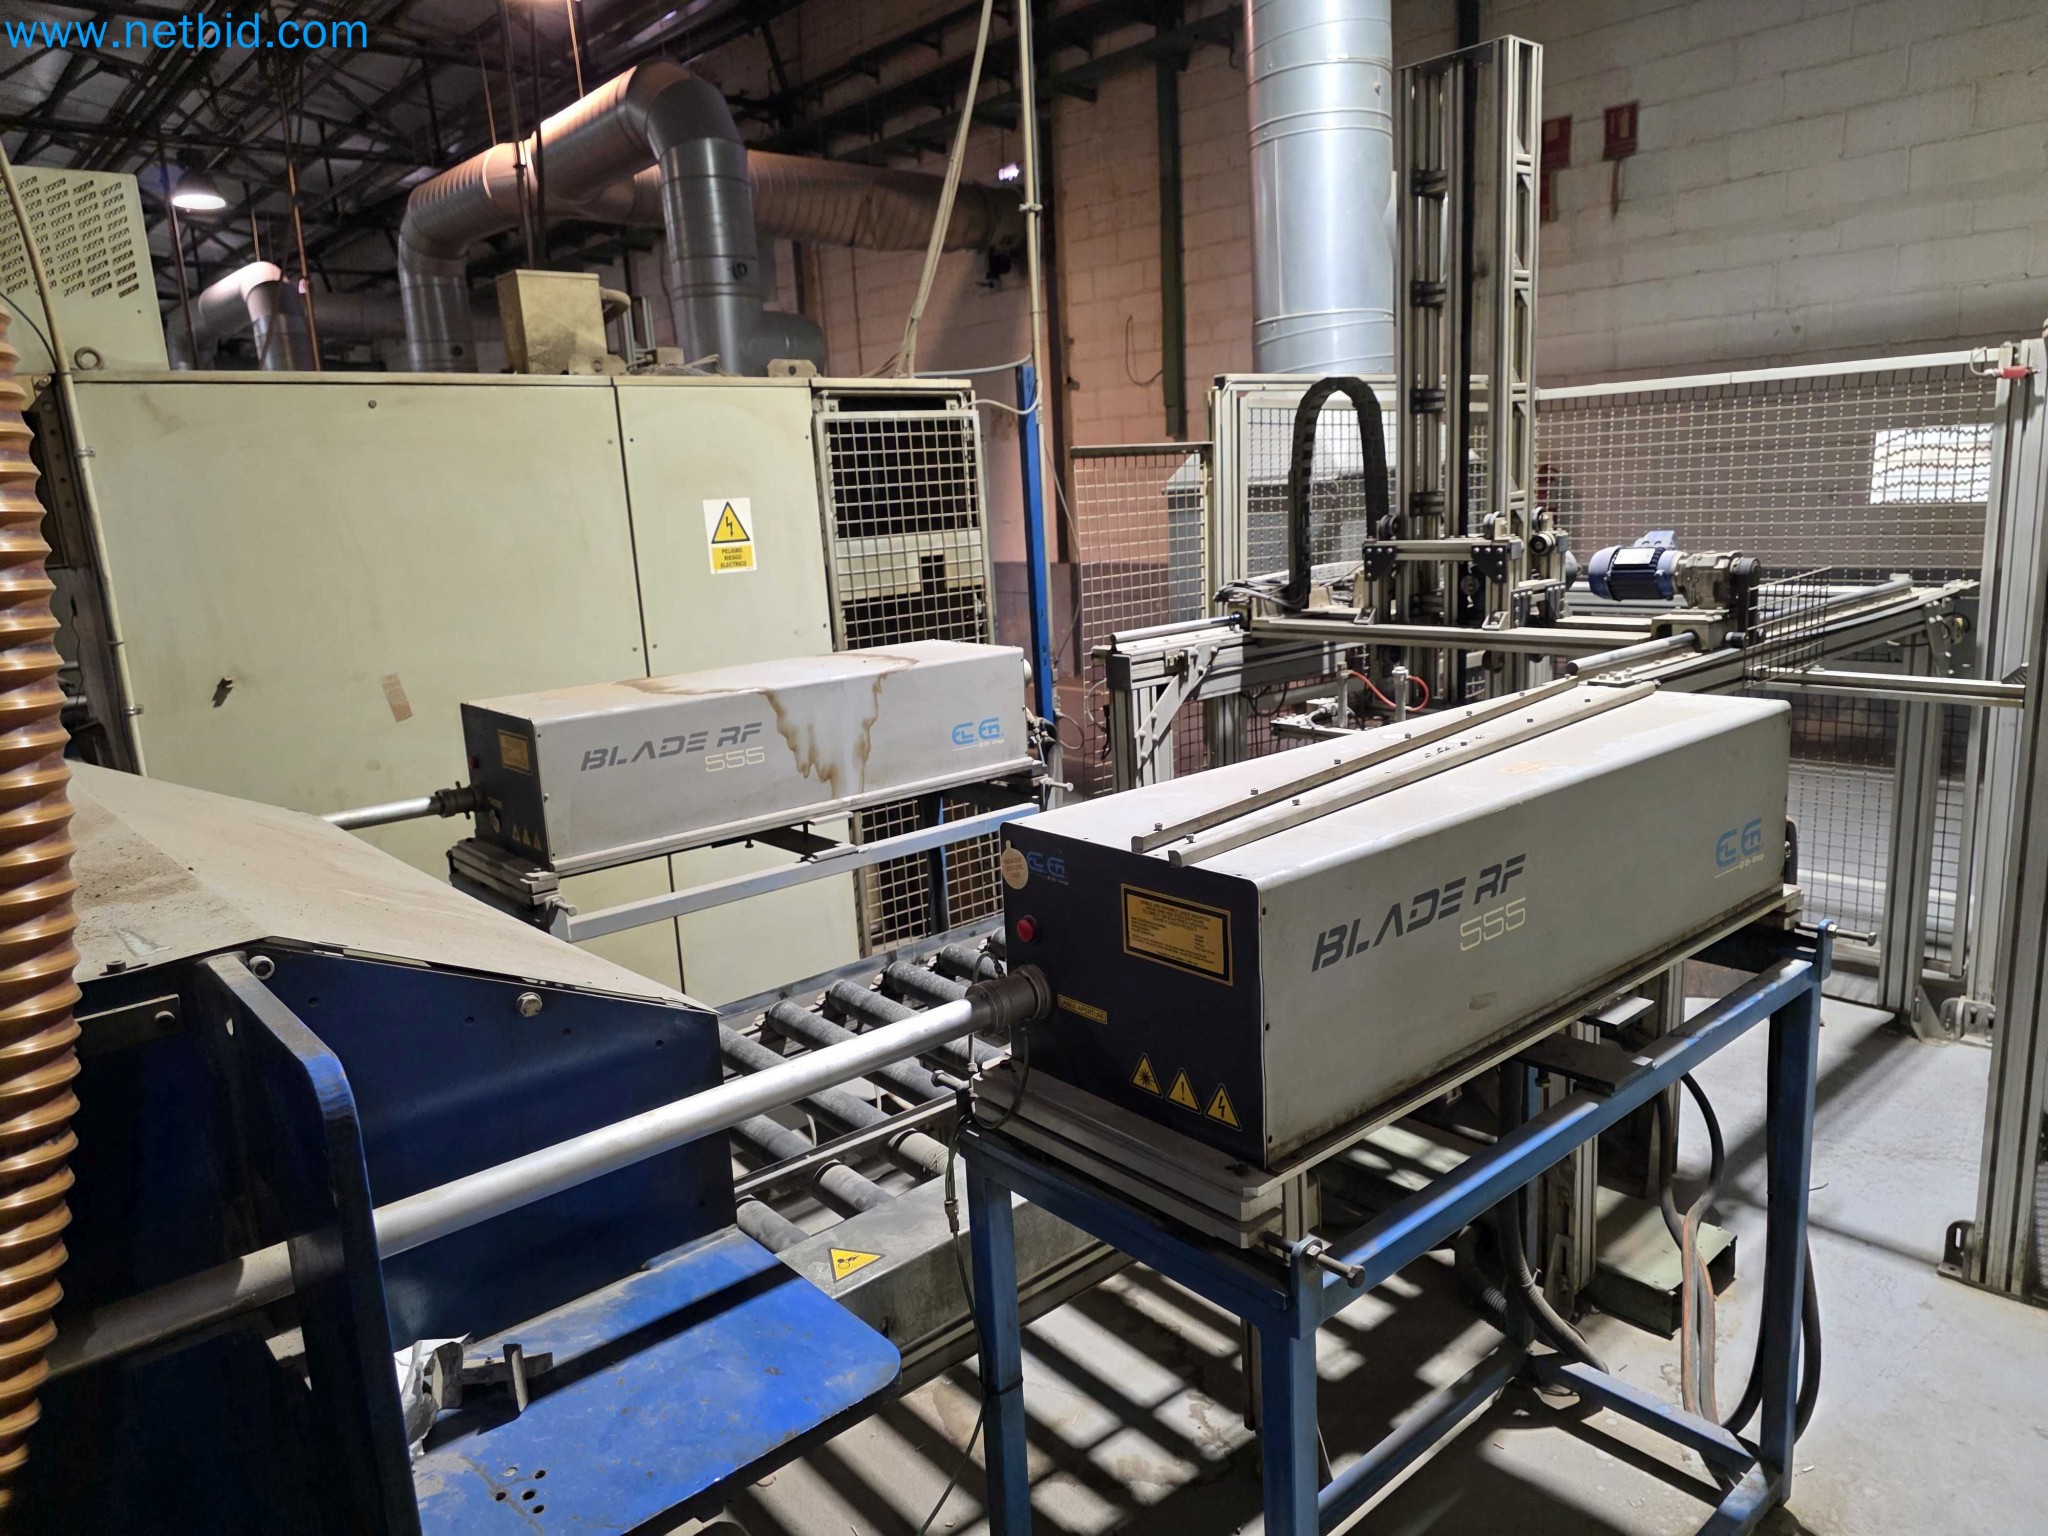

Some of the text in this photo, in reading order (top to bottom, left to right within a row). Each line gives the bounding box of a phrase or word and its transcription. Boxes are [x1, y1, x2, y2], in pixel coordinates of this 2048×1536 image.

[580, 722, 762, 772] BLADE RF
[705, 746, 765, 773] 555
[1311, 853, 1526, 973] BLADE RF
[1460, 897, 1526, 951] 555
